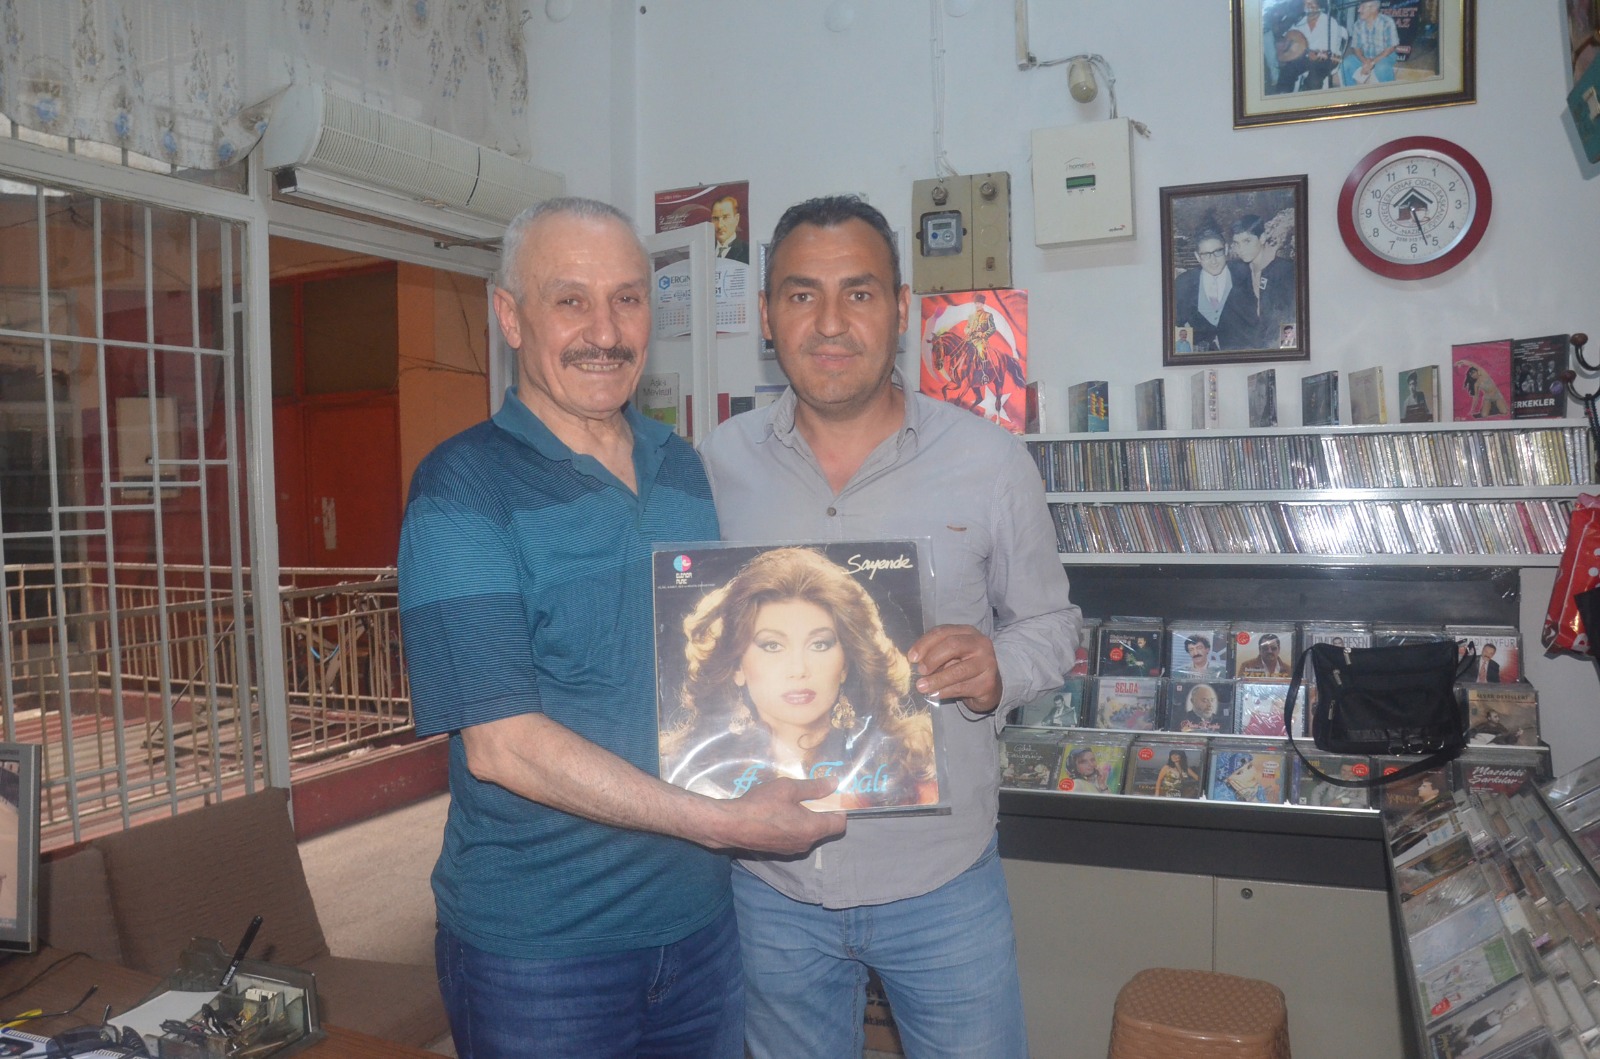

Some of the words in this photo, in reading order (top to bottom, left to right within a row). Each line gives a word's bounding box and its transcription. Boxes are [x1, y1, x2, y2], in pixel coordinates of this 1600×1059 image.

[1406, 165, 1418, 174] 12
[1432, 168, 1436, 177] 1
[1387, 173, 1395, 181] 11
[1449, 182, 1455, 191] 2
[1371, 189, 1381, 199] 10
[1455, 200, 1462, 209] 3
[1365, 209, 1372, 218] 9
[1448, 221, 1455, 230] 4
[1372, 228, 1379, 237] 8
[1389, 241, 1395, 250] 7
[1432, 237, 1439, 246] 5
[1411, 244, 1417, 253] 6
[841, 554, 913, 580] Sayende
